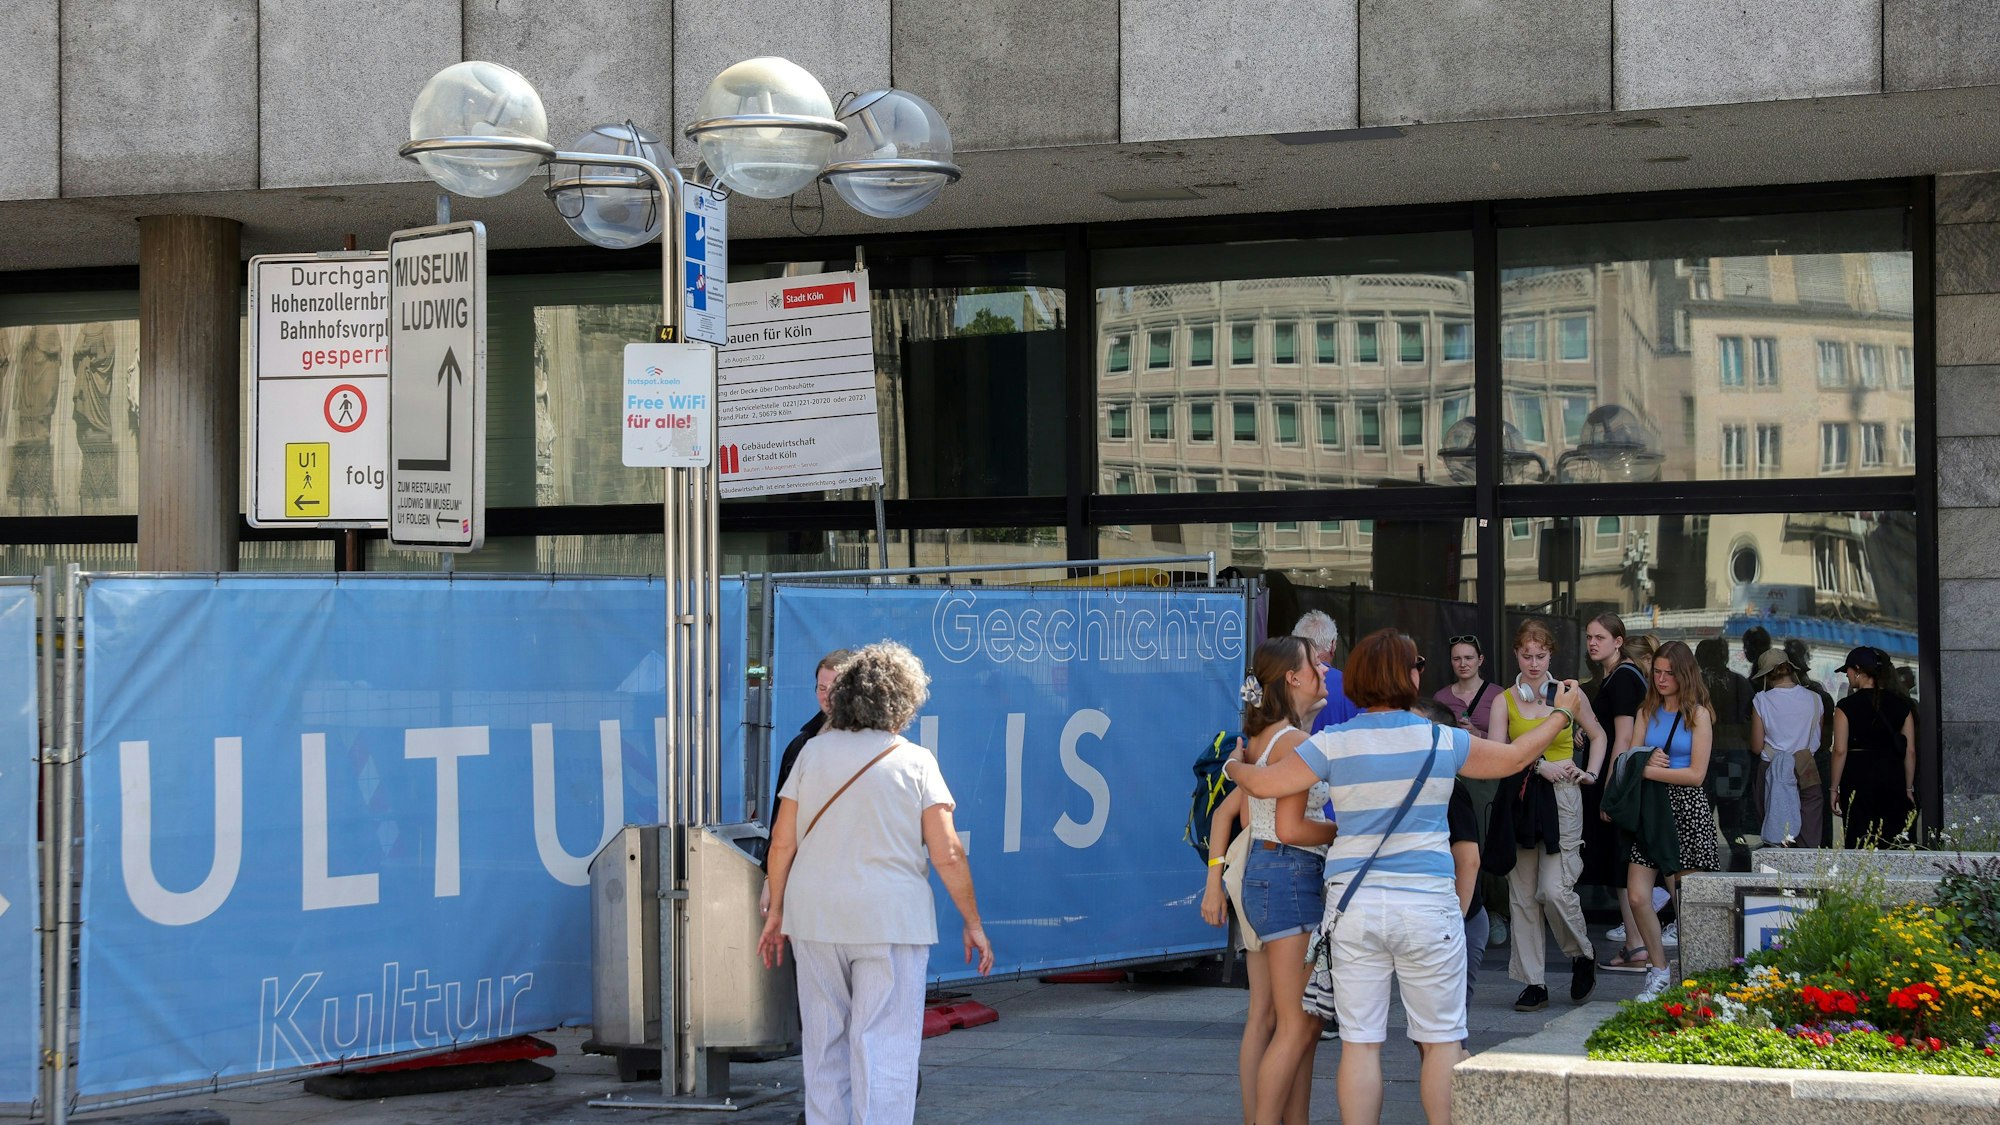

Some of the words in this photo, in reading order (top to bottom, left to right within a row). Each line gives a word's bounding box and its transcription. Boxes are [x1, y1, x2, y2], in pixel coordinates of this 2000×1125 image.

[395, 252, 468, 287] MUSEUM
[292, 266, 388, 289] Durchgan
[272, 291, 388, 312] Hohenzollernbr
[786, 294, 806, 304] Stadt
[806, 292, 824, 302] Köln
[402, 297, 468, 330] LUDWIG
[660, 327, 674, 340] 47
[763, 328, 781, 341] für
[784, 324, 812, 338] Köln
[732, 356, 750, 364] August
[730, 388, 739, 396] der
[740, 386, 758, 394] Decke
[760, 384, 773, 392] über
[774, 382, 815, 392] Dombauhütte
[628, 395, 664, 410] Free
[669, 395, 706, 410] WiFi
[848, 394, 866, 402] 20721
[778, 408, 792, 416] Köln
[628, 414, 650, 428] für
[656, 414, 692, 428] alle!
[742, 436, 816, 451] Gebäudewirtschaft
[299, 452, 316, 468] U1
[742, 454, 756, 462] der
[757, 452, 778, 461] Stadt
[780, 450, 797, 459] Köln
[398, 482, 410, 492] ZUM
[411, 482, 452, 494] RESTAURANT
[425, 498, 432, 509] IM
[398, 512, 405, 524] U1
[406, 513, 431, 524] FOLGEN
[932, 590, 1242, 662] Geschichte
[257, 962, 533, 1072] Kultur
